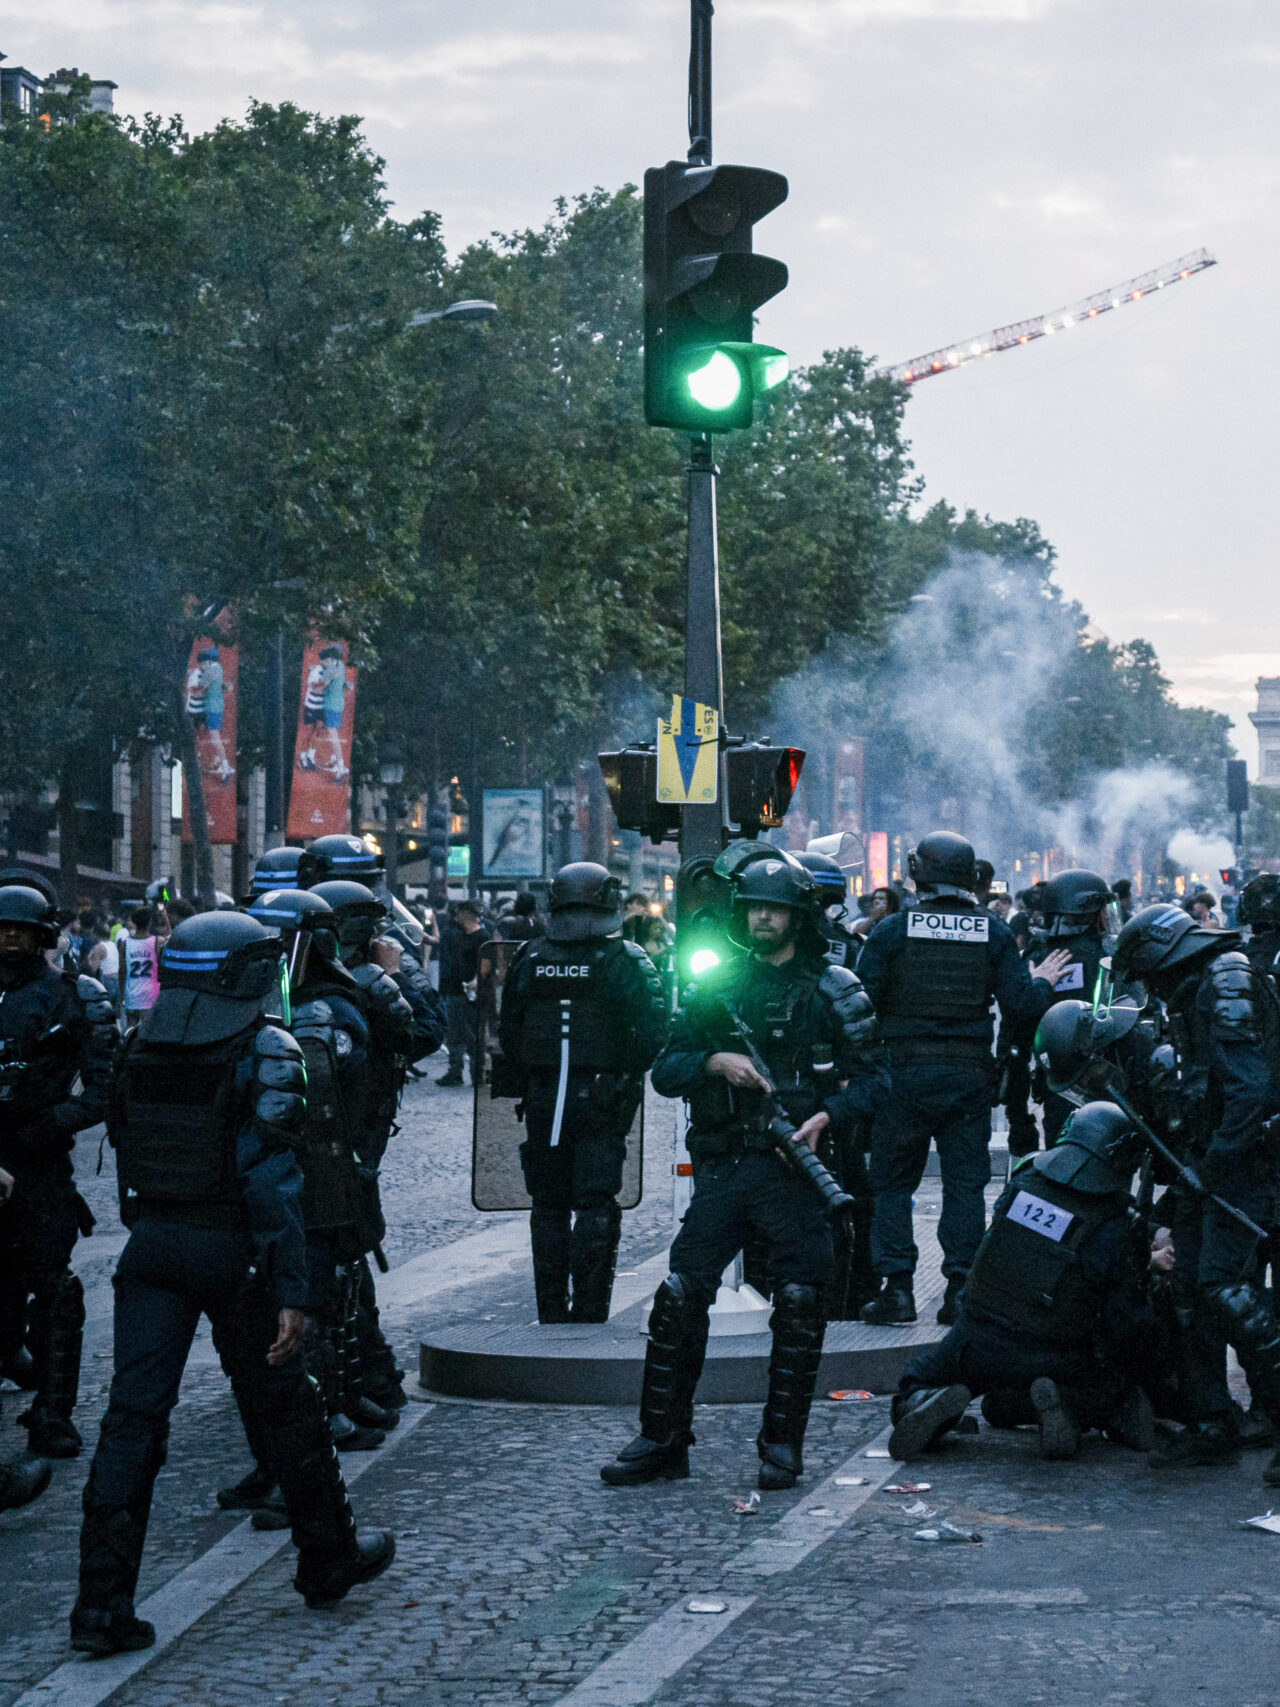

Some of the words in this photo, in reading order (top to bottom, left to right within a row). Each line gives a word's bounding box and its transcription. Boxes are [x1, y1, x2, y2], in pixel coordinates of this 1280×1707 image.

[911, 913, 985, 932] POLICE
[130, 960, 153, 978] 22
[536, 965, 589, 977] POLICE
[1023, 1203, 1057, 1229] 122
